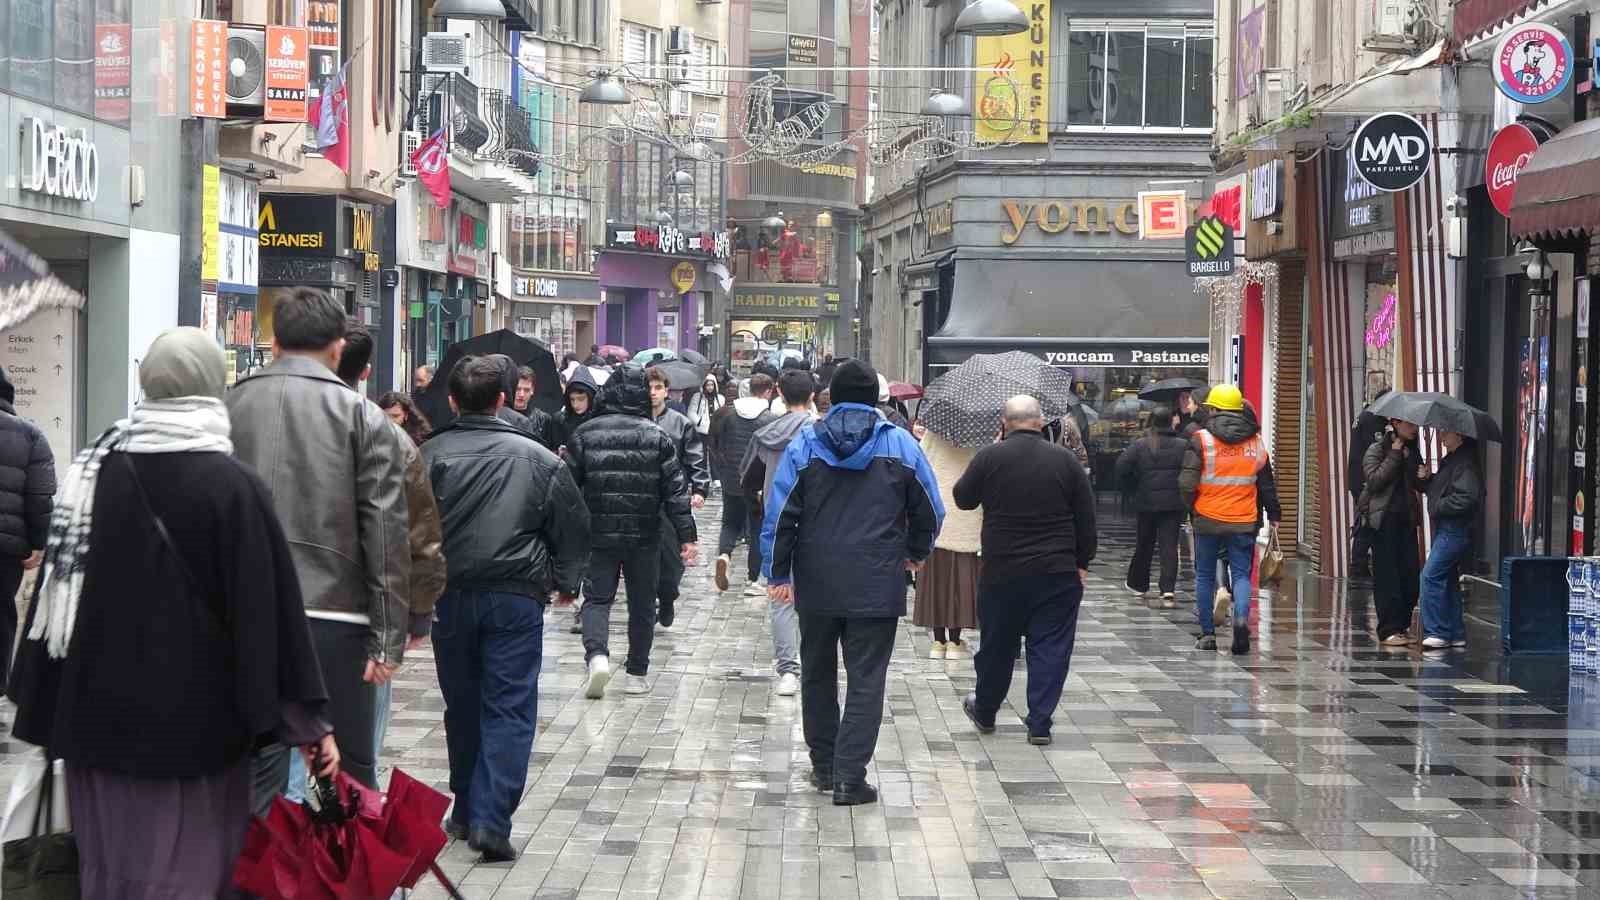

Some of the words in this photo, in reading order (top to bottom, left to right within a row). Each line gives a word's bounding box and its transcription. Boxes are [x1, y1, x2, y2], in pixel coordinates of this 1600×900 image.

[268, 89, 305, 100] SAHAF
[1360, 131, 1425, 165] MAD
[31, 117, 98, 202] DeFacto
[258, 232, 323, 248] STANESİ
[1190, 261, 1230, 273] BARGELLO
[1046, 351, 1114, 365] yoncam
